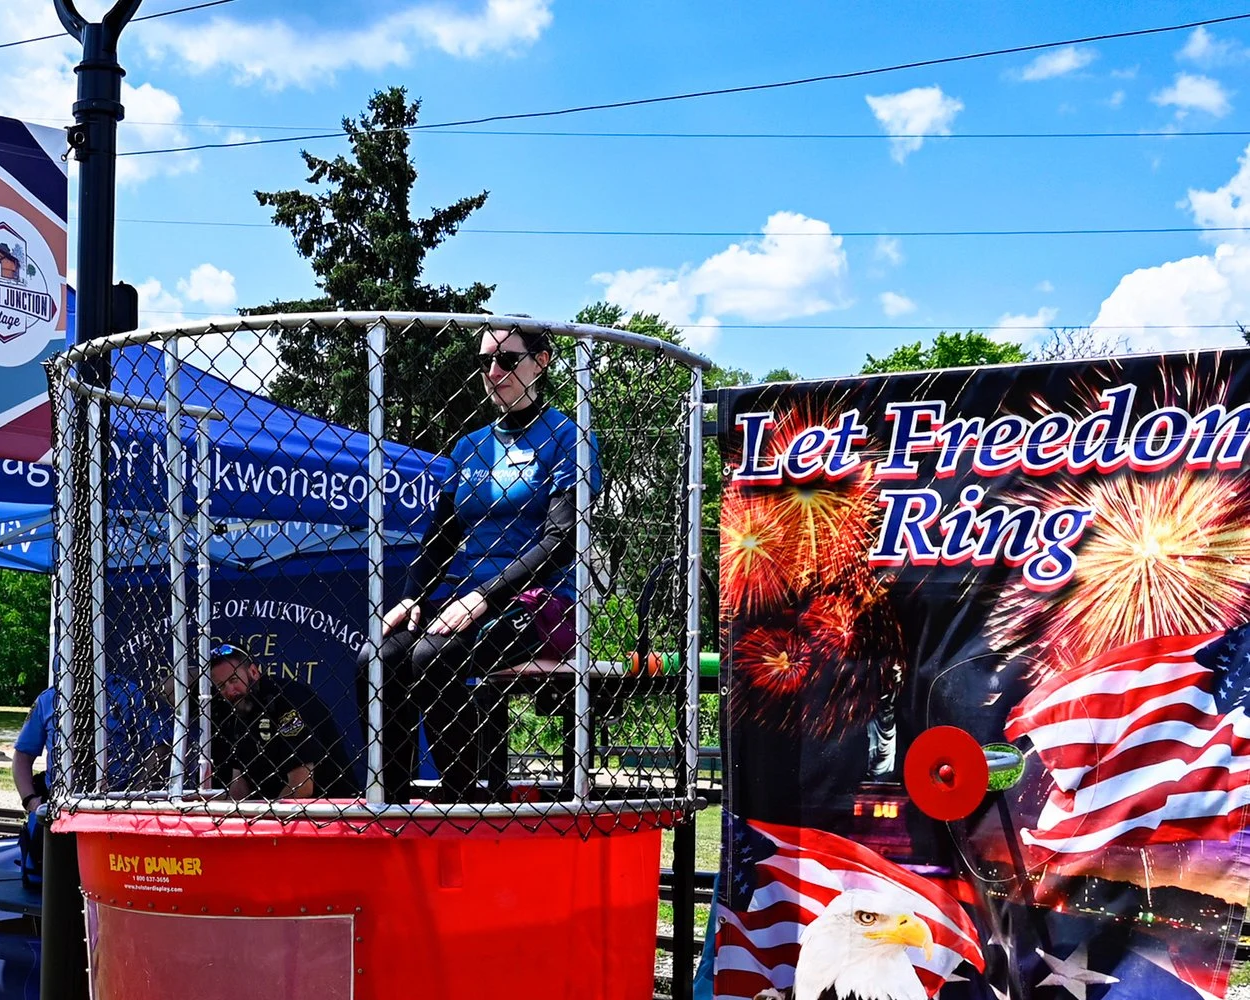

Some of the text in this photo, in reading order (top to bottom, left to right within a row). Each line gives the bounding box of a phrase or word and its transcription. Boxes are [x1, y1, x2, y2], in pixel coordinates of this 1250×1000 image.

[4, 288, 48, 318] JUNCTION
[732, 408, 868, 486] Let
[381, 467, 443, 512] Poli
[868, 484, 1095, 592] Ring
[224, 599, 251, 619] OF
[252, 602, 370, 652] MUKWONAG
[109, 853, 203, 876] EASY DUNKER
